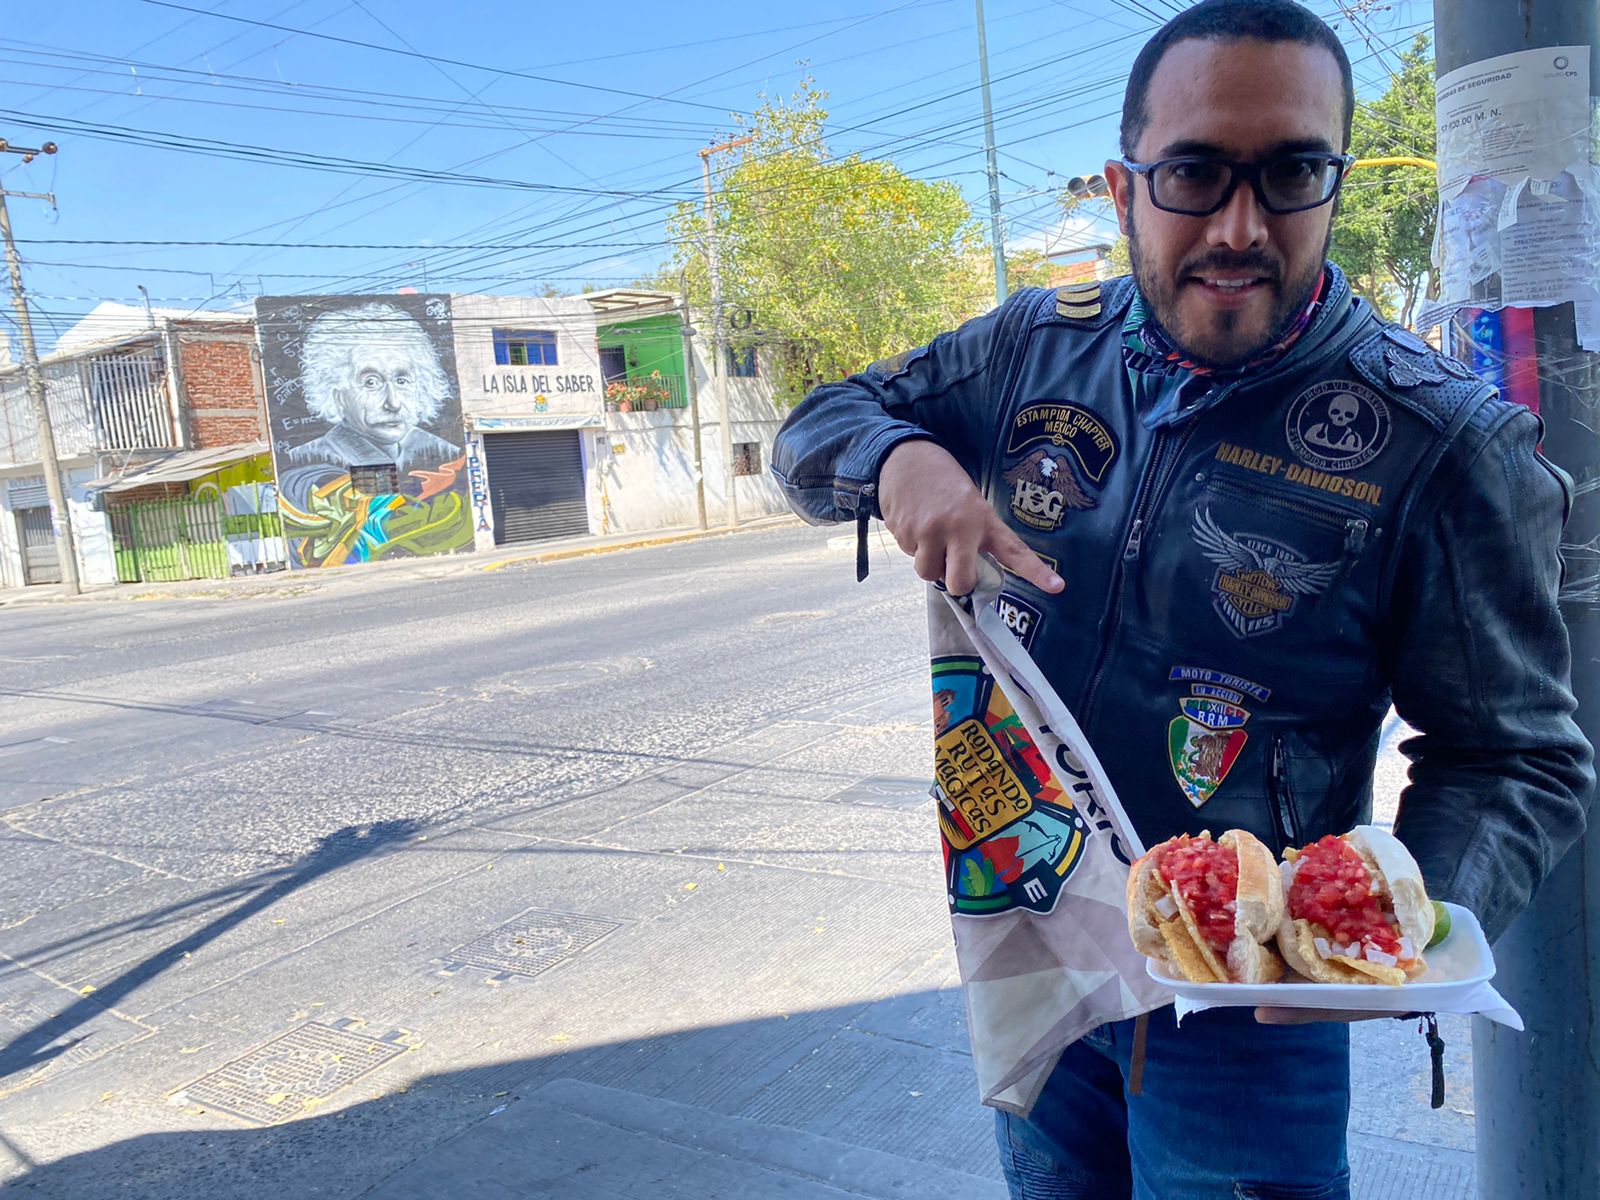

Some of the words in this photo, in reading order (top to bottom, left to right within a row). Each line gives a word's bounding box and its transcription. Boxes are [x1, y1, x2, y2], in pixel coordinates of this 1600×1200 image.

[1467, 73, 1512, 89] SEGURIDAD
[483, 374, 499, 393] LA
[503, 374, 527, 393] ISLA
[532, 375, 552, 393] DEL
[556, 374, 595, 393] SABER
[1017, 409, 1071, 428] ESTAMPIDA
[1073, 414, 1111, 452] CHAPTER
[1044, 421, 1078, 438] MEXICO
[1014, 479, 1065, 521] HOG
[1247, 540, 1273, 554] SINCE
[998, 599, 1032, 635] HOG
[1181, 668, 1211, 680] MOTO
[1219, 674, 1263, 696] TURISTA
[1186, 699, 1246, 718] MEXICO
[1022, 877, 1048, 904] E
